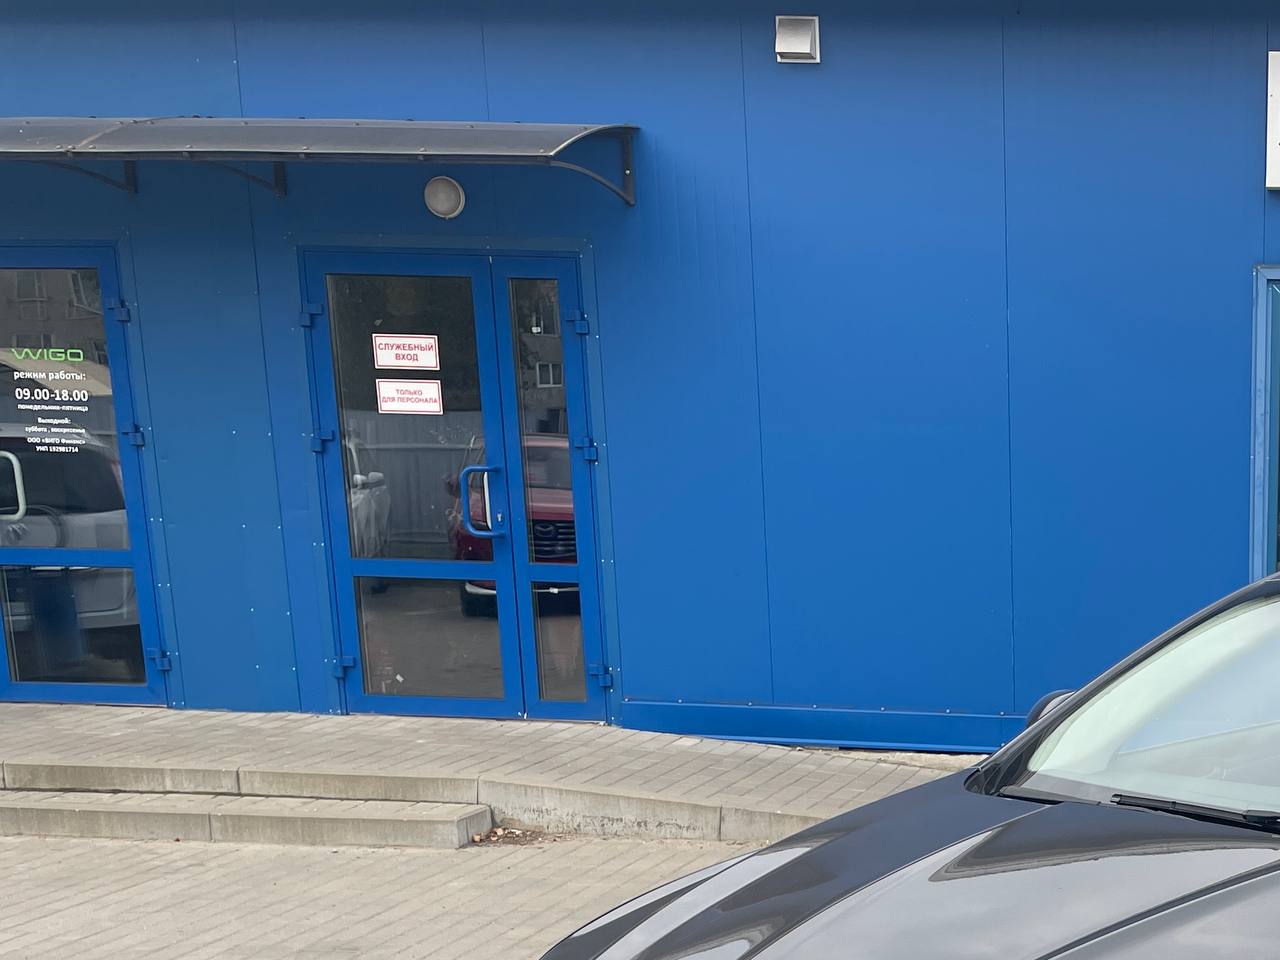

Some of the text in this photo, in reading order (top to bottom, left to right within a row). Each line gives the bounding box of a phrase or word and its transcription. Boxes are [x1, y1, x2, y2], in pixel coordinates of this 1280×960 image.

[377, 342, 434, 352] СЛУЖЕБНЫЙ
[12, 348, 84, 361] WIGO
[395, 353, 418, 361] ВХОД
[14, 370, 87, 381] режим работы:
[15, 388, 89, 401] 09.00-18.00
